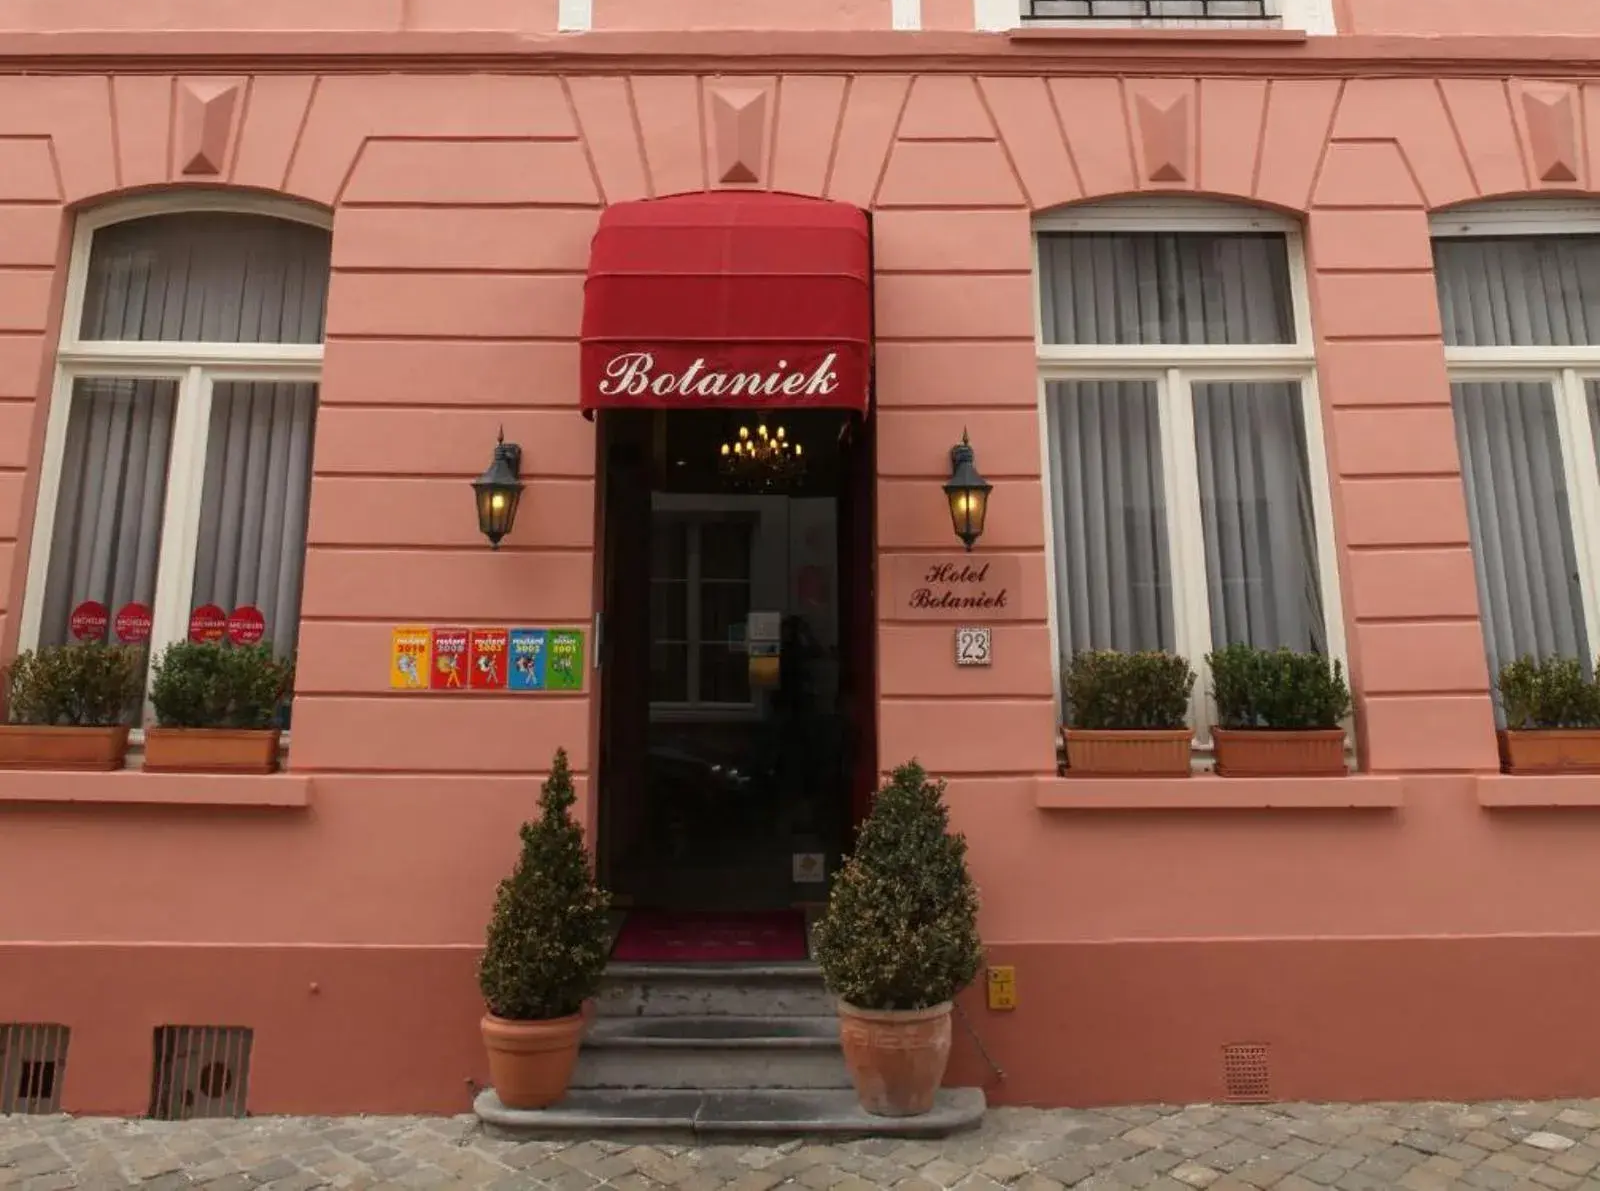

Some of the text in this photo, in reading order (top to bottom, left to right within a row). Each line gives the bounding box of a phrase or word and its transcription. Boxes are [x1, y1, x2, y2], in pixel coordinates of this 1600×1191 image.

[599, 352, 839, 396] Botaniek
[925, 562, 990, 583] Hotel
[908, 588, 1007, 609] Botaniek
[961, 632, 987, 660] 23
